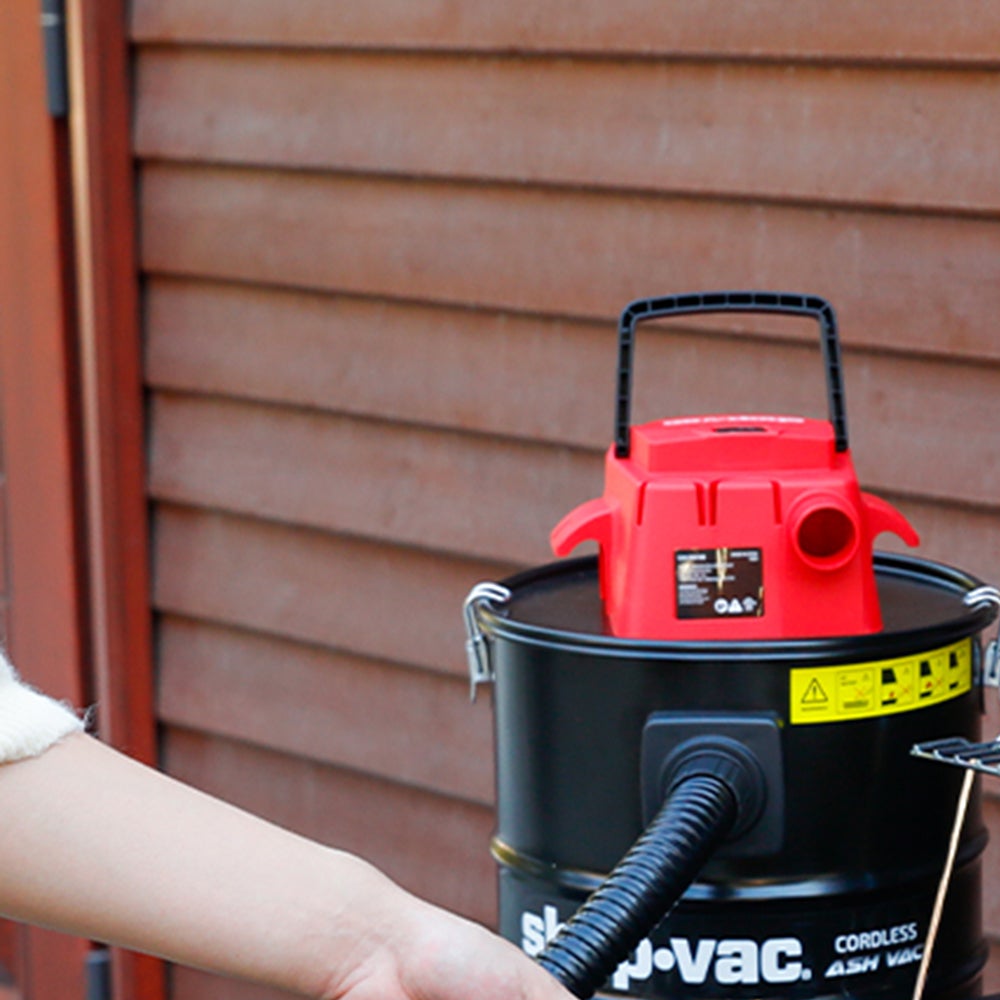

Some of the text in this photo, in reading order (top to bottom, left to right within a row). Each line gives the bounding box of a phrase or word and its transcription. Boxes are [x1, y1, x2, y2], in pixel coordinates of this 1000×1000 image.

[834, 922, 918, 954] CORDLESS
[824, 943, 925, 979] ASH VAC
